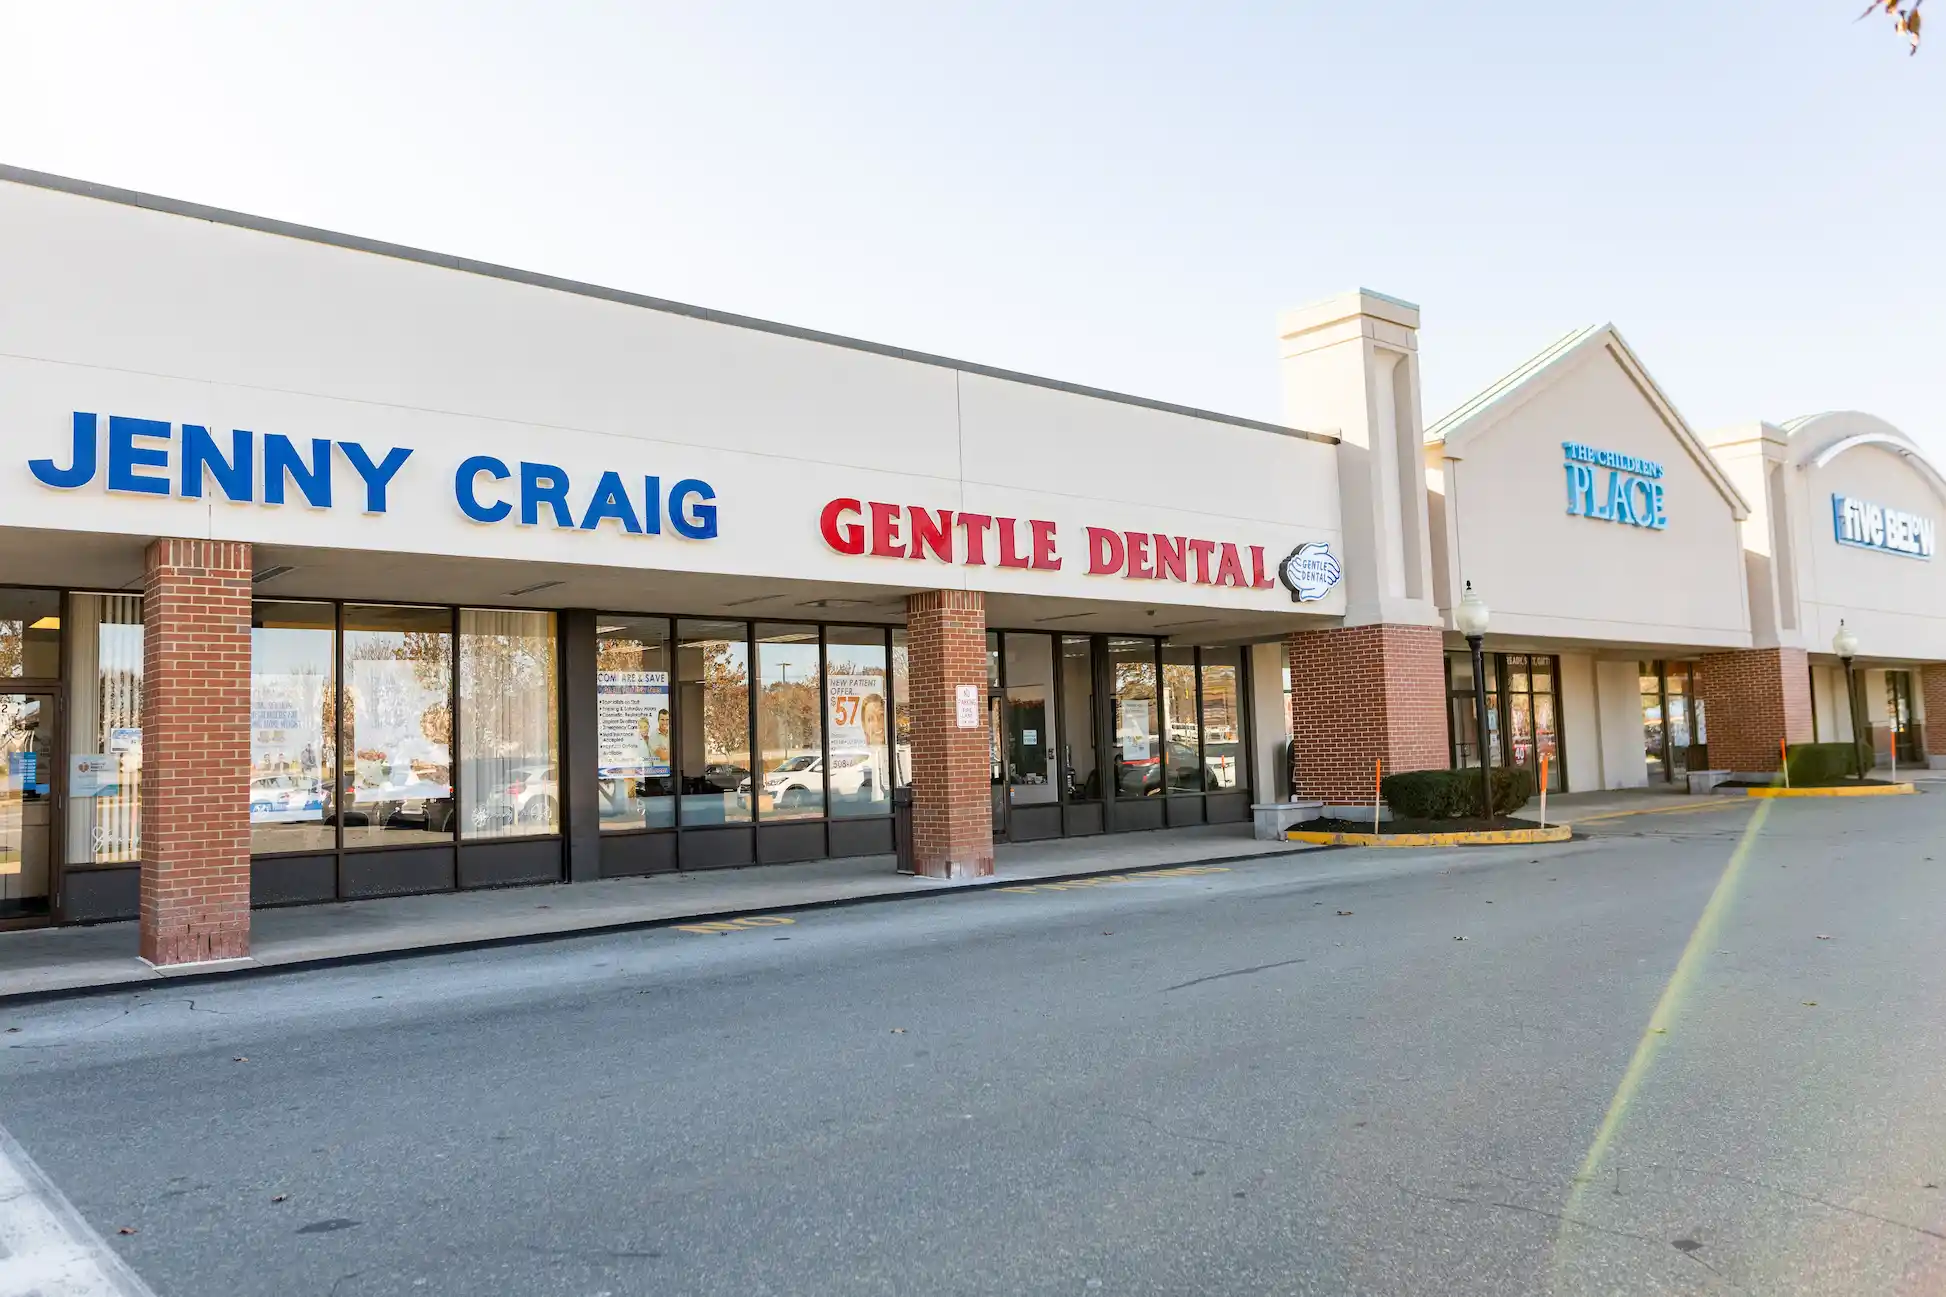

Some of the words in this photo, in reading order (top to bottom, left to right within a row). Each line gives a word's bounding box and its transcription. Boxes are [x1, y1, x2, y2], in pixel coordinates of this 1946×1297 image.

[28, 411, 413, 514] JENNY
[455, 455, 718, 540] CRAIG
[1561, 442, 1593, 462] THE
[1594, 451, 1664, 479] CHILDREN'S
[1564, 463, 1667, 530] PLACE
[1841, 497, 1883, 545] five
[820, 497, 1062, 571] GENTLE
[1083, 526, 1275, 589] DENTAL
[1302, 560, 1327, 571] GENTLE
[1302, 571, 1327, 583] DENTAL
[598, 673, 636, 682] COMARE
[645, 674, 665, 682] SAVE
[830, 679, 848, 687] NEW
